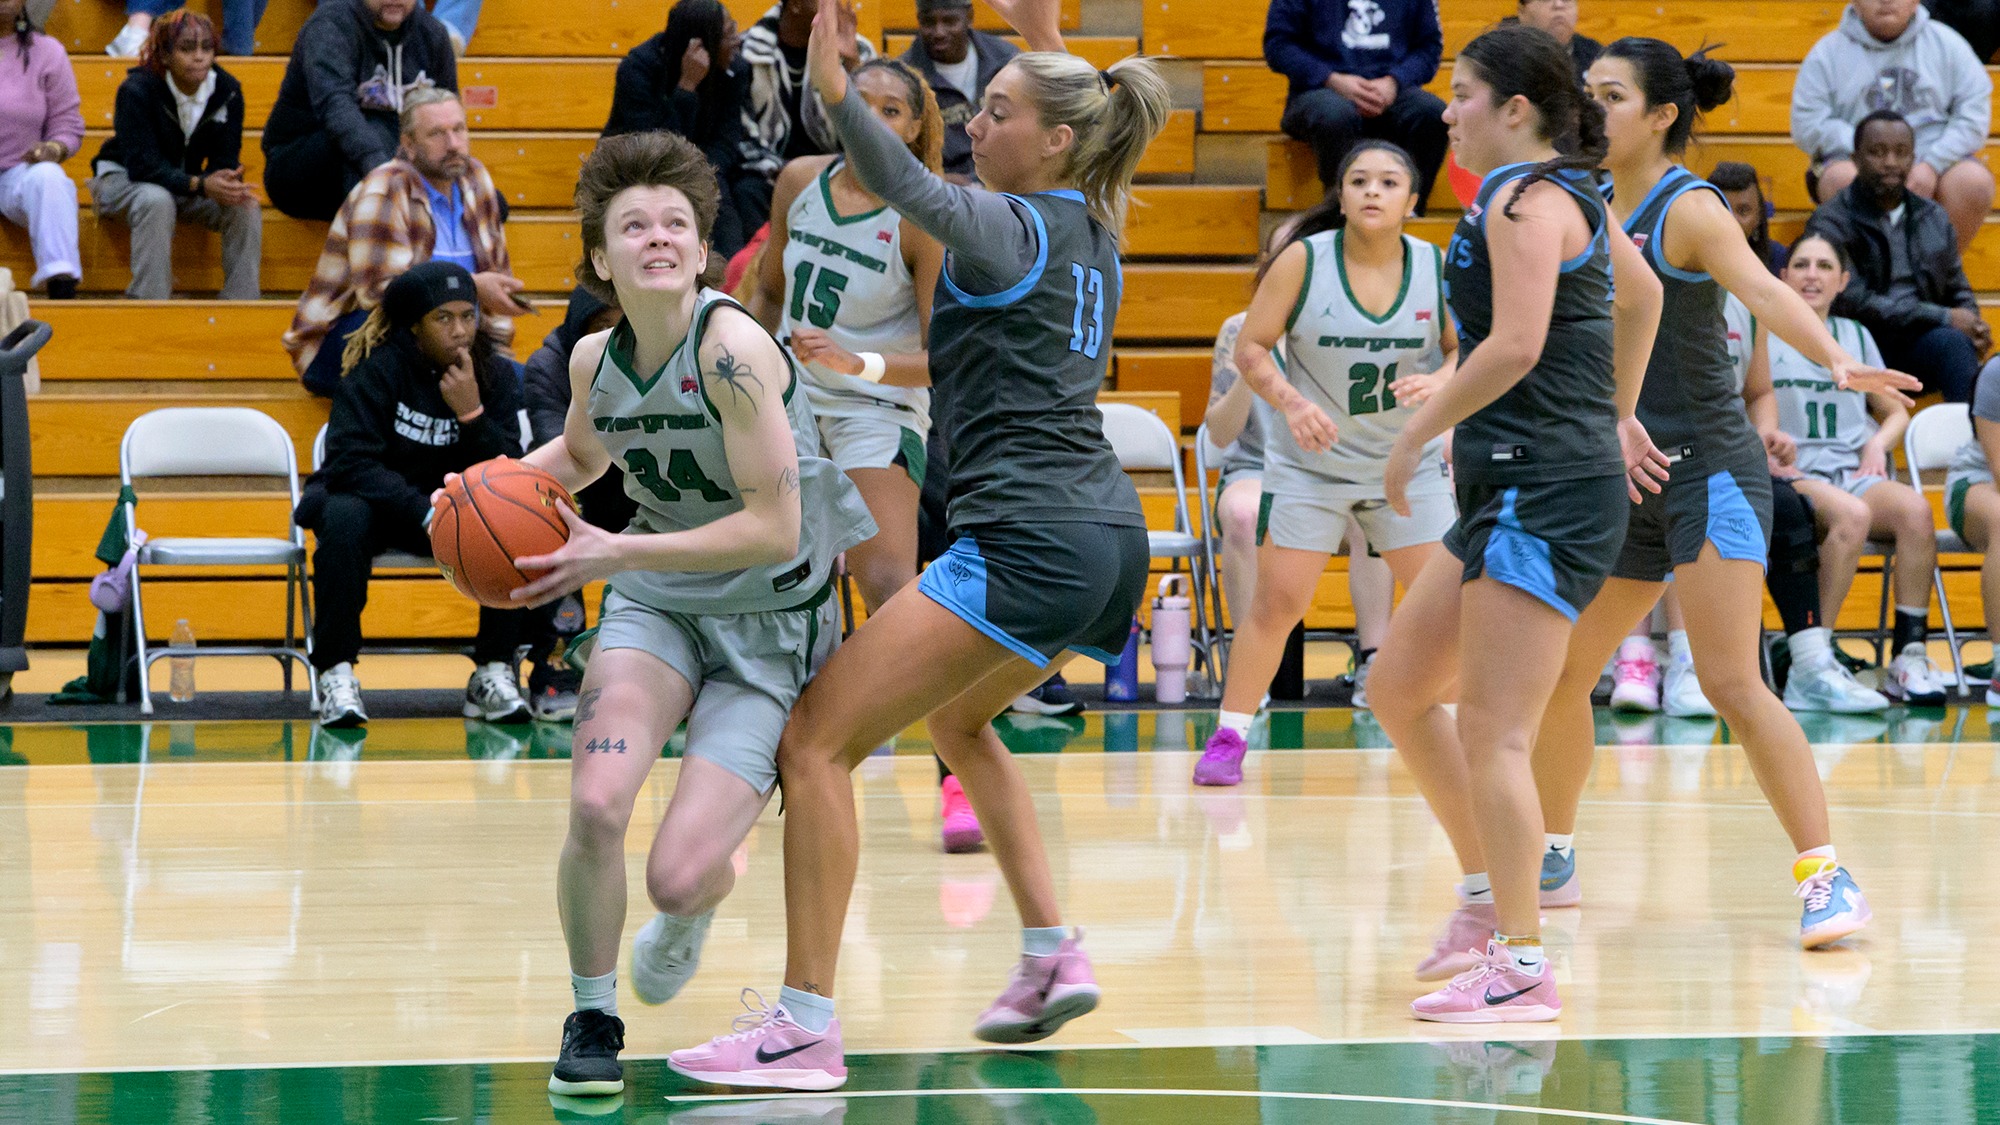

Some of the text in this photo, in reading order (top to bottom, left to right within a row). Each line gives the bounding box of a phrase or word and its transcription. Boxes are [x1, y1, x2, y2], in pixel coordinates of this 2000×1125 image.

[790, 261, 849, 329] 15
[1069, 261, 1104, 360] 13
[1317, 336, 1424, 352] evergree
[1805, 401, 1837, 438] 11
[623, 448, 733, 502] 34
[585, 737, 627, 754] 444
